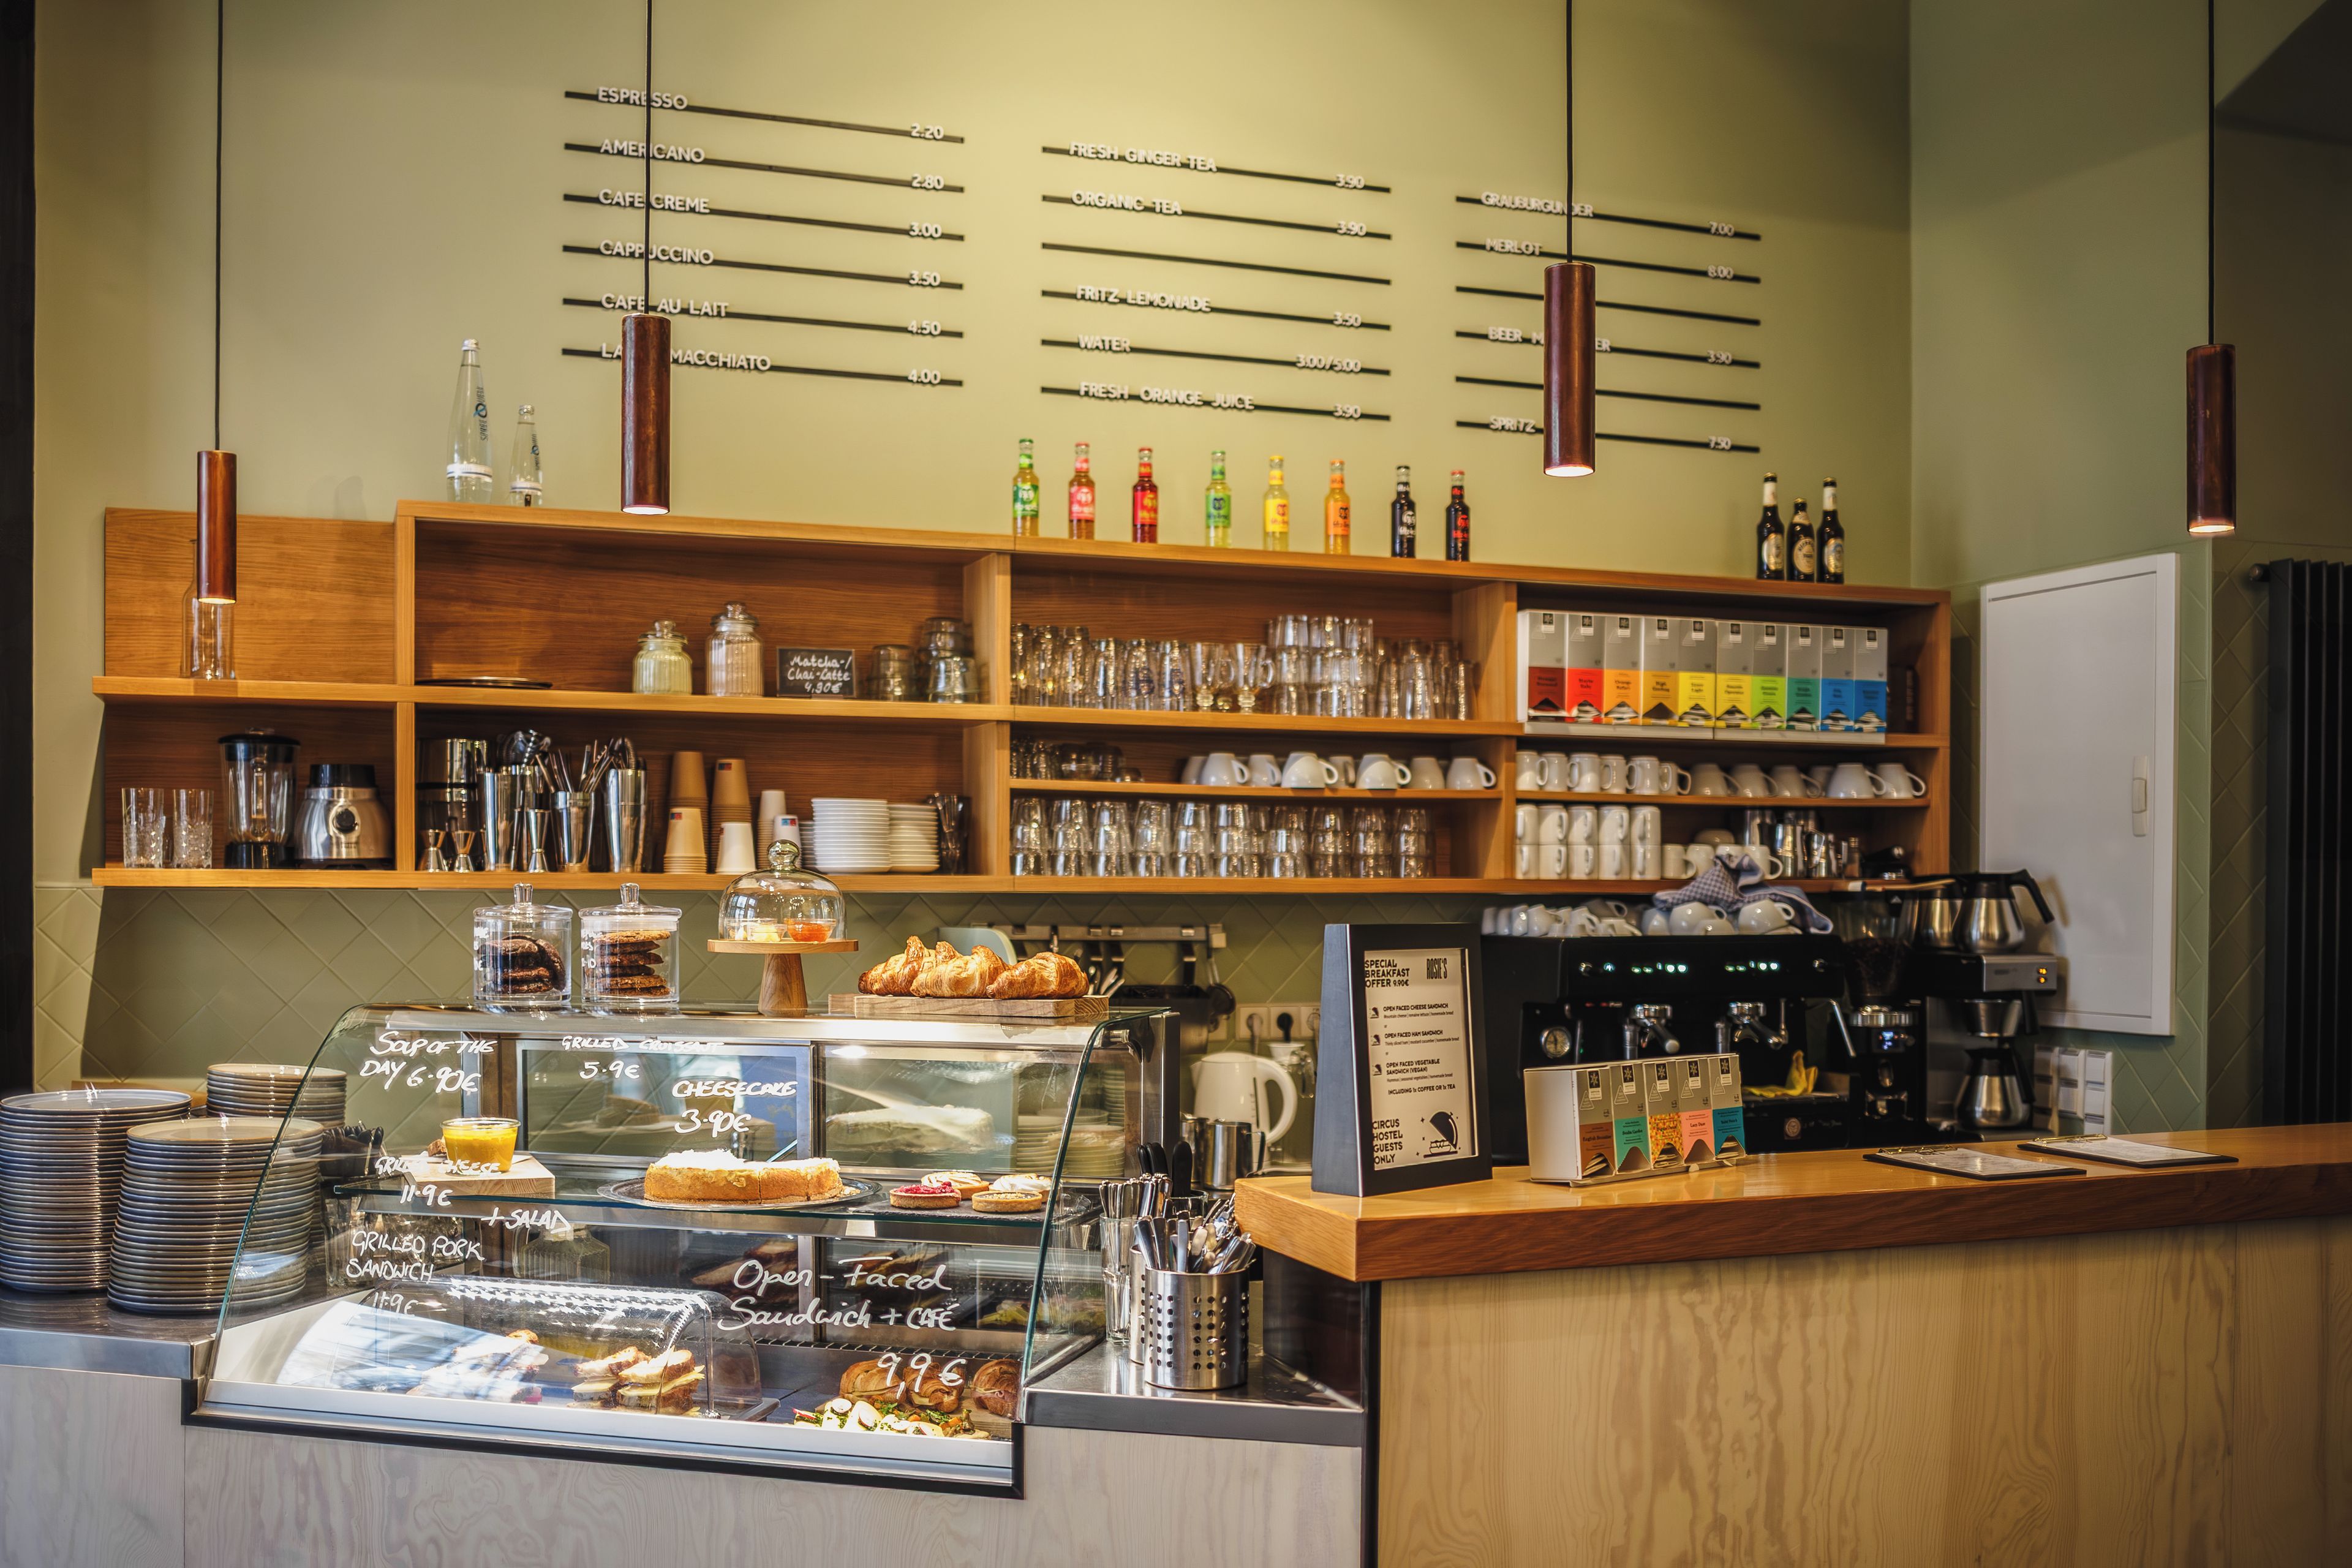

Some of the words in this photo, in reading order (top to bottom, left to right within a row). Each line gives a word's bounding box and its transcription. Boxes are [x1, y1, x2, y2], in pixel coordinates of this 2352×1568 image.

[597, 86, 688, 110] ESPRESSO
[911, 123, 944, 140] 2.20
[600, 139, 705, 163] AMERICANO
[911, 174, 944, 190] 2.80
[1069, 142, 1119, 160] FRESH
[1125, 148, 1182, 168] GINGER
[1187, 155, 1217, 172] TEA
[1335, 174, 1365, 189] 3.90
[598, 189, 644, 208] CAFE
[651, 194, 710, 214] CREME
[909, 222, 942, 238] 3.00
[1071, 190, 1145, 211] ORGANIC
[1152, 199, 1183, 215] TEA
[1337, 221, 1367, 237] 3.90
[1709, 221, 1735, 237] 7.00
[600, 240, 714, 265] CAPPUCCINO
[909, 271, 941, 287] 3.50
[1485, 238, 1543, 256] MERLOT
[1707, 265, 1734, 280] 8.00
[601, 293, 645, 311] CAFE
[657, 298, 681, 314] AU
[689, 300, 729, 318] LAIT
[908, 321, 941, 336] 4.50
[1076, 285, 1120, 303] FRITZ
[1126, 290, 1211, 312] LEMONADE
[1333, 312, 1362, 327] 3.50
[1077, 334, 1131, 353] WATER
[1488, 326, 1523, 342] BEER
[1707, 350, 1732, 365] 3.90
[671, 348, 771, 371] MACCHIATO
[908, 369, 941, 385] 4.00
[1079, 382, 1129, 400] FRESH
[1140, 386, 1204, 407] ORANGE
[1211, 392, 1254, 410] JUICE
[1333, 404, 1362, 419] 3.90
[1489, 416, 1536, 433] SPRITZ
[1365, 959, 1397, 968] SPECIAL
[1427, 958, 1447, 979] ROSIE'S
[1365, 968, 1410, 978] BREAKFAST
[1365, 979, 1391, 988] OFFER
[426, 1041, 455, 1054] OF
[454, 1040, 498, 1054] THE
[562, 1035, 630, 1050] GRILLED
[359, 1060, 407, 1090] DAY
[671, 1080, 798, 1098] CHEESECAKE
[1372, 1118, 1400, 1129] CIRCUS
[1373, 1130, 1403, 1141] HOSTEL
[1373, 1141, 1403, 1153] GUESTS
[1374, 1154, 1395, 1164] ONLY
[374, 1156, 429, 1175] GRILL
[505, 1208, 571, 1234] SALAD
[352, 1231, 426, 1257] GRILLED
[432, 1235, 485, 1262] PORK
[346, 1257, 434, 1284] SANDWICH
[717, 1295, 871, 1331] Sandwich
